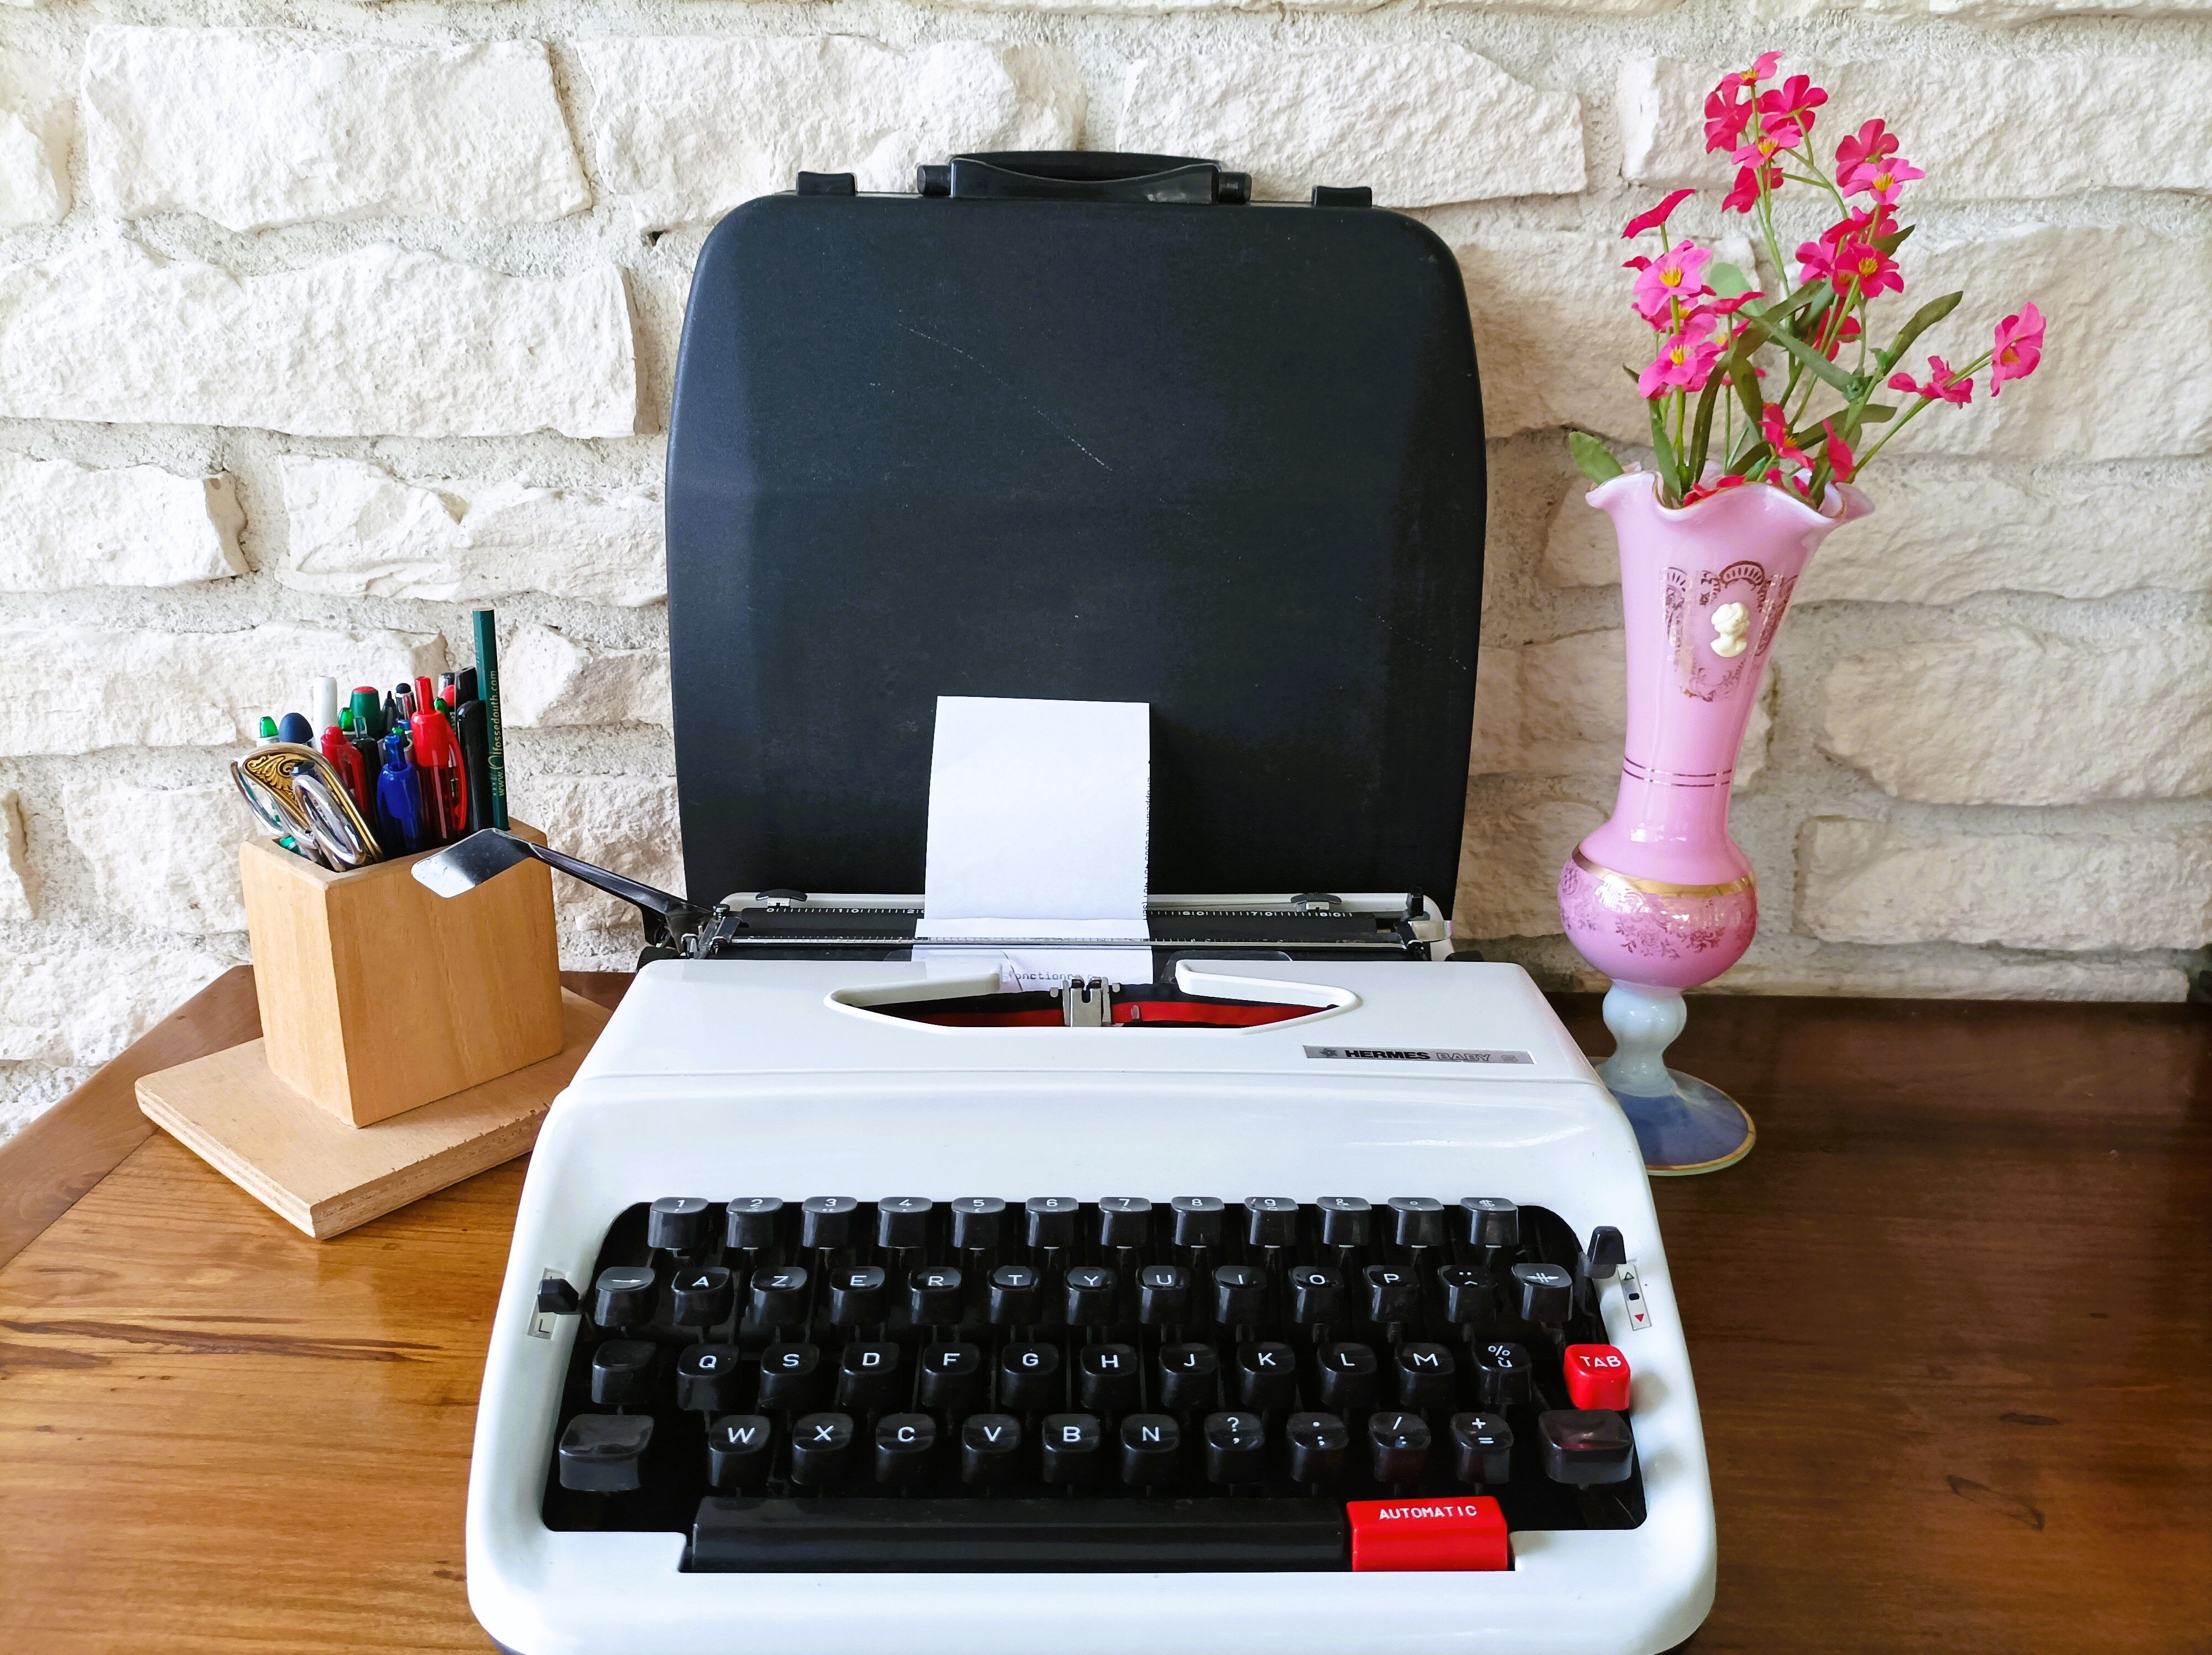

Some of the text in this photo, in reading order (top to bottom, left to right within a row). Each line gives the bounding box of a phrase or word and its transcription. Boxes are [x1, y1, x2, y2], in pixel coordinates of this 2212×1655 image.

[1344, 1050, 1431, 1059] HERMES
[1436, 1052, 1490, 1061] BABY
[677, 1199, 685, 1208] 1
[749, 1199, 763, 1207] 2
[825, 1198, 837, 1207] 3
[899, 1199, 912, 1207] 4
[1046, 1199, 1058, 1207] 6
[1191, 1198, 1203, 1206] 8
[691, 1273, 1400, 1287] A Z E R T Y U I O P
[1488, 1345, 1511, 1356] %
[698, 1352, 1438, 1368] Q S D F G H J K L M
[1580, 1356, 1622, 1368] TAB
[727, 1427, 755, 1444] W
[813, 1425, 834, 1441] X
[898, 1426, 915, 1443] C
[984, 1426, 1001, 1442] V
[1063, 1426, 1081, 1442] B
[1142, 1426, 1160, 1441] N
[1227, 1417, 1239, 1432] ?
[1379, 1505, 1477, 1519] AUTOMATIC
